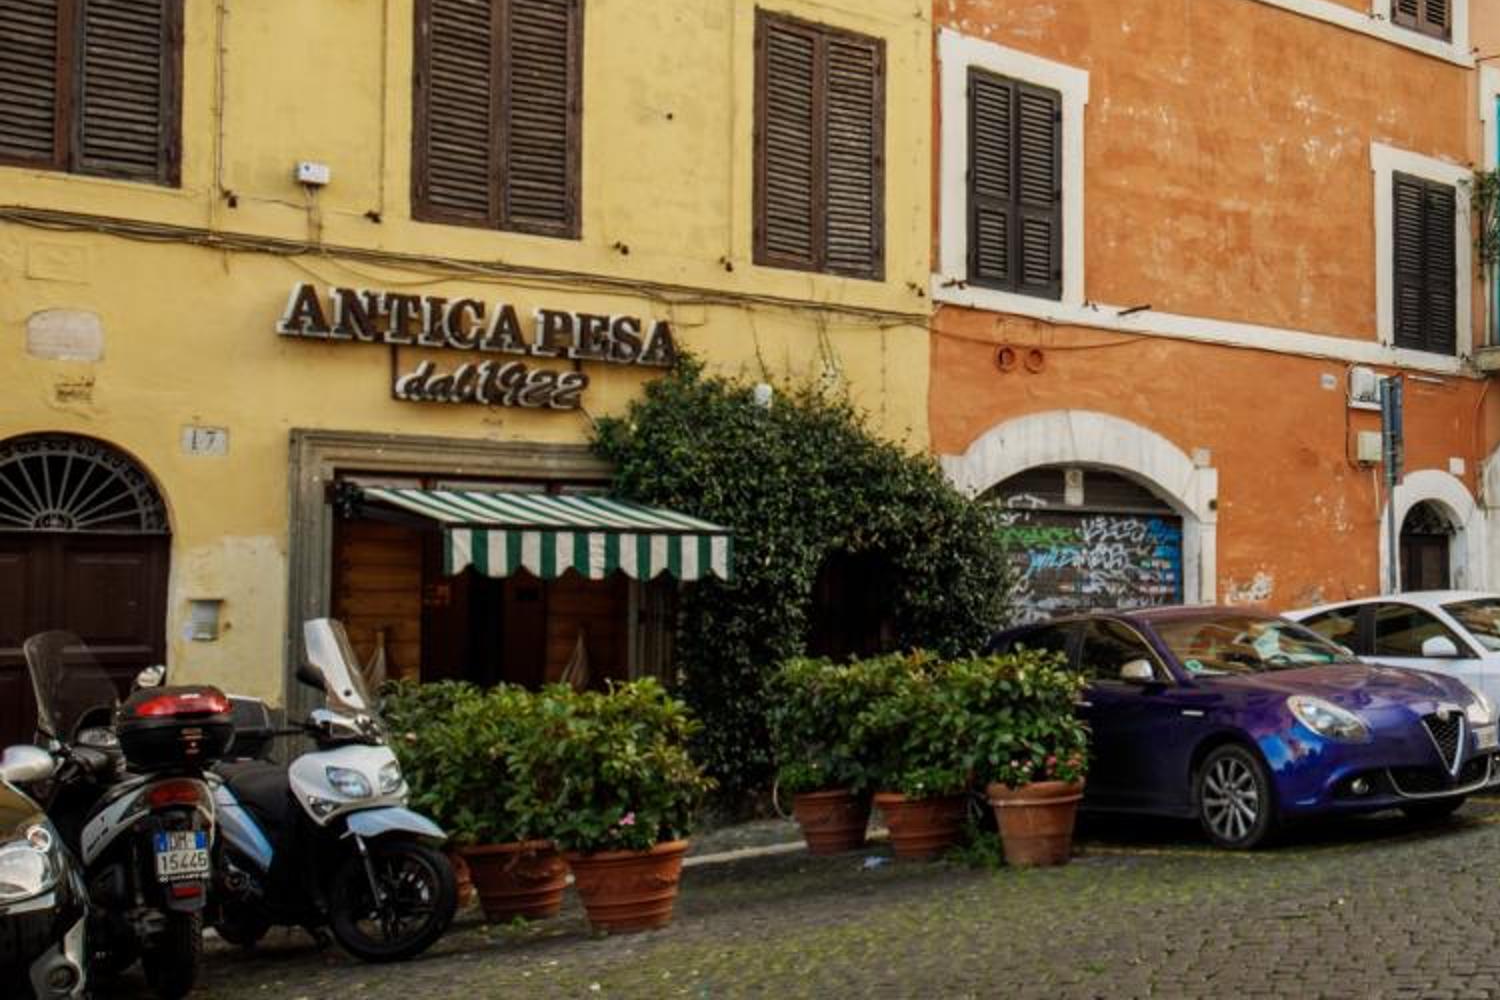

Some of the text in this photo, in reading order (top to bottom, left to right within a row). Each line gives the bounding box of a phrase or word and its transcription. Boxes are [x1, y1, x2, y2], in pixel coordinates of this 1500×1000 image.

[277, 281, 677, 368] ANTICA PESA
[191, 429, 217, 451] 17
